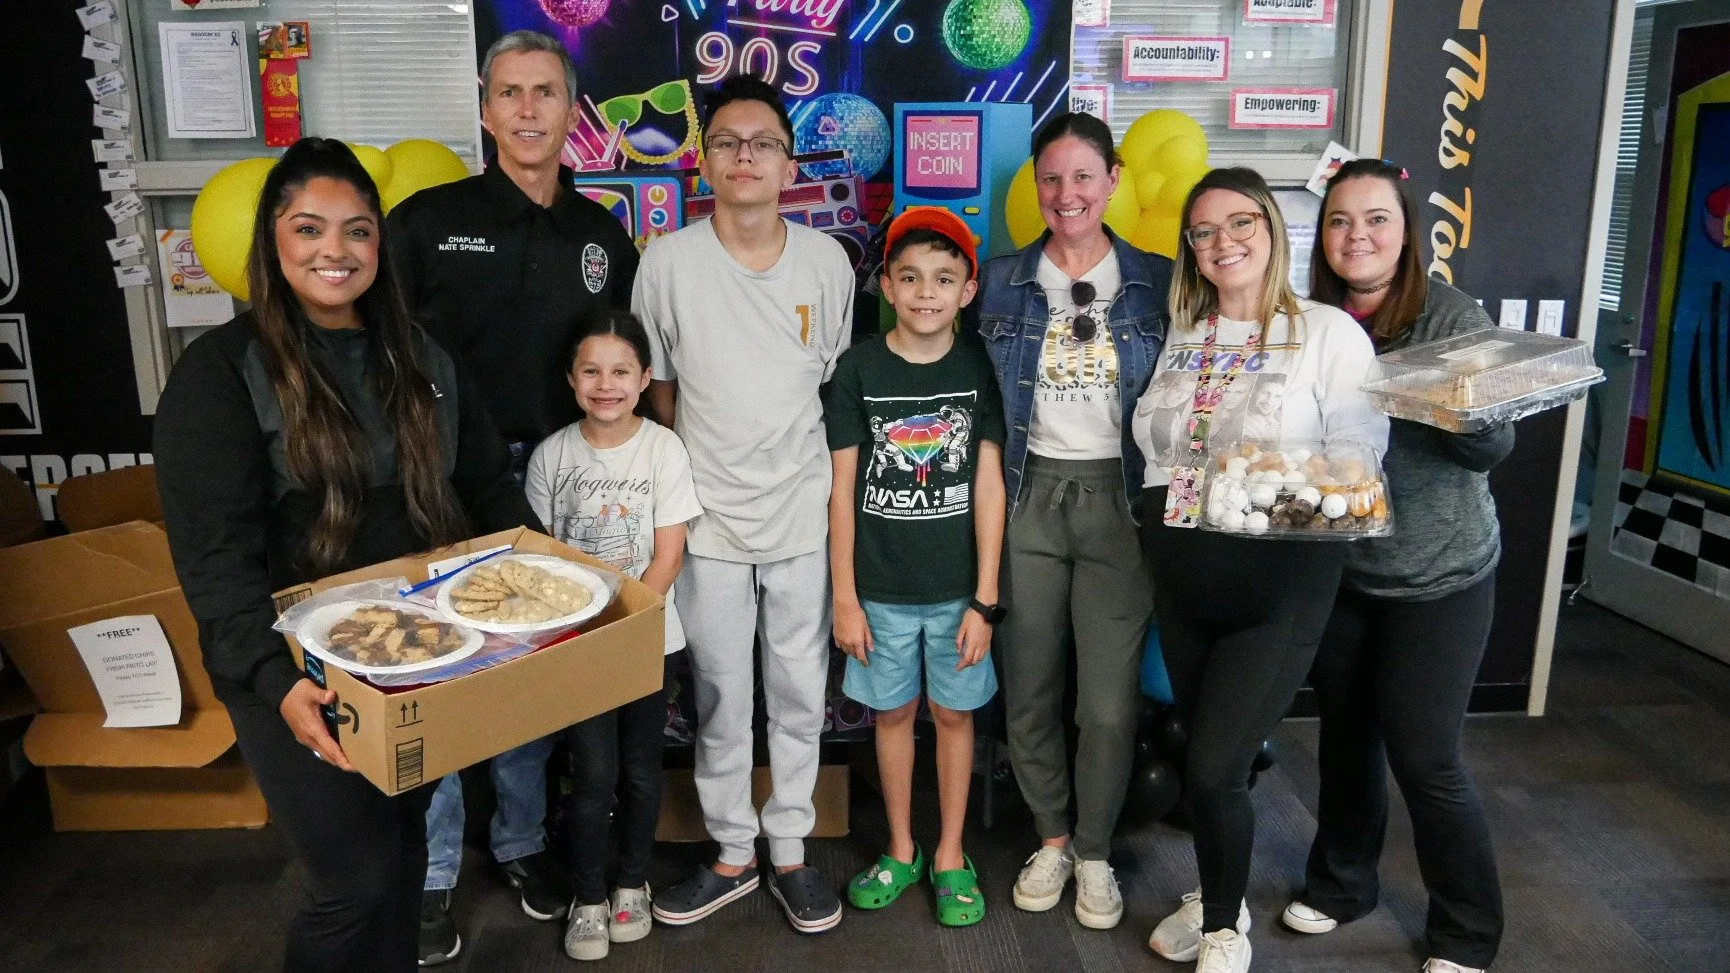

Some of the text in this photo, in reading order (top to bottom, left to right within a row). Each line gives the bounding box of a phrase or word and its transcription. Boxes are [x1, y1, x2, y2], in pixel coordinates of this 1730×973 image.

[1133, 46, 1220, 61] Accountability:
[1244, 97, 1320, 112] Empowering:
[1438, 34, 1487, 169] This
[909, 131, 974, 151] INSERT
[917, 156, 963, 175] COIN
[438, 243, 495, 252] NATE SPRINKLE
[448, 236, 486, 245] CHAPLAIN
[556, 465, 652, 500] Hogwarts
[869, 485, 929, 508] NASA
[922, 507, 937, 515] SPACE
